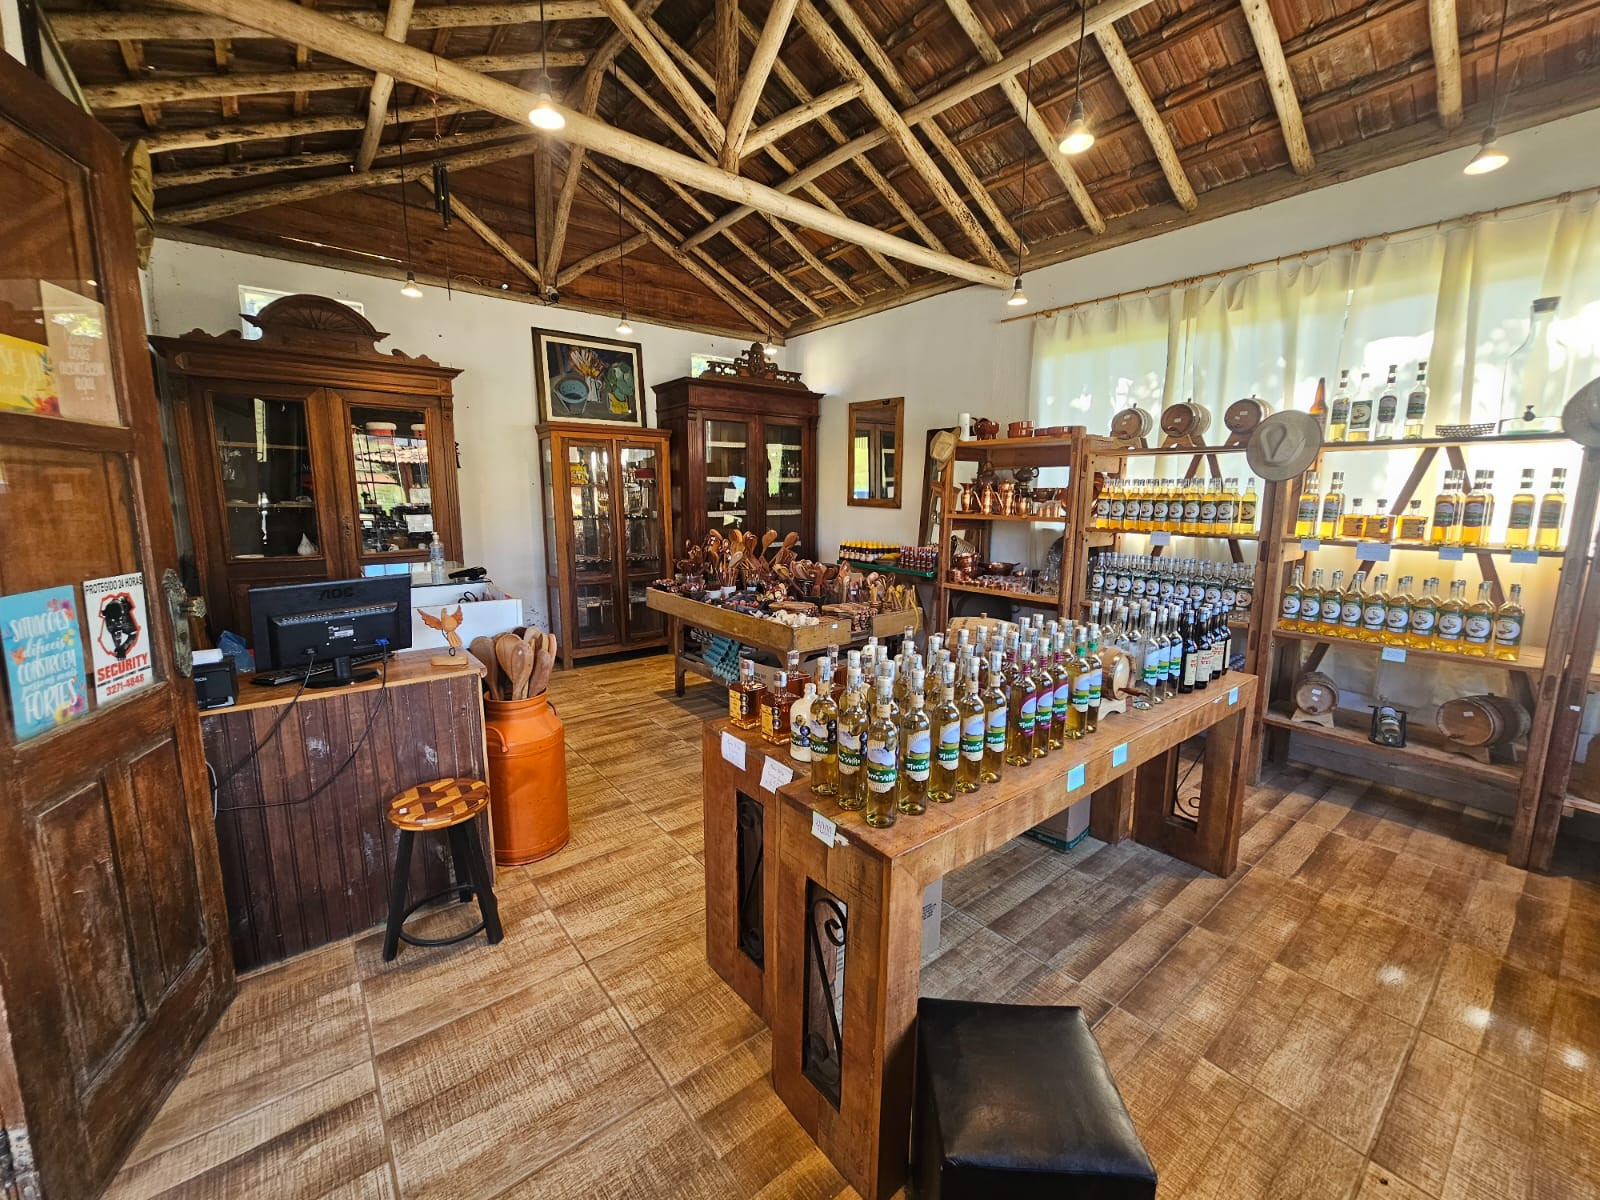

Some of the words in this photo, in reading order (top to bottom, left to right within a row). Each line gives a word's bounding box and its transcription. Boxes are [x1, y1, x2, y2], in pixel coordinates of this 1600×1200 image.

[85, 579, 118, 595] PROTEGIDO
[118, 579, 125, 589] 24
[125, 575, 144, 588] HORAS
[318, 587, 353, 600] AOC
[97, 652, 148, 682] SECURITY
[24, 678, 78, 723] FORTES
